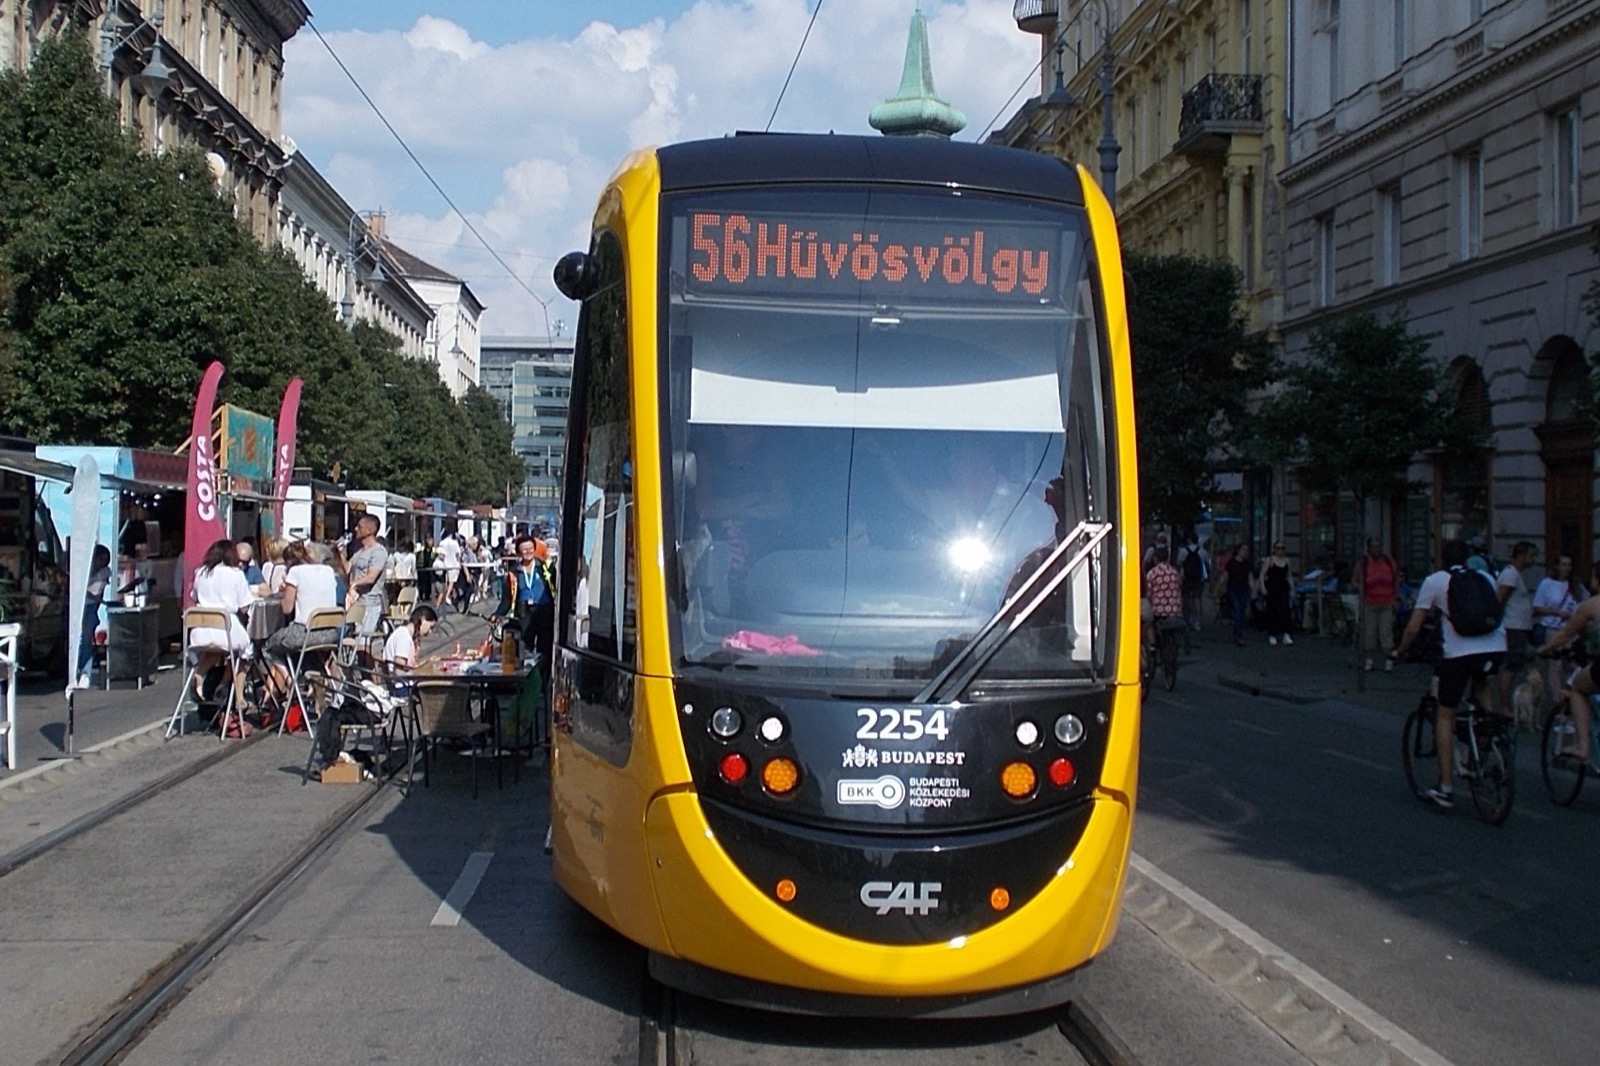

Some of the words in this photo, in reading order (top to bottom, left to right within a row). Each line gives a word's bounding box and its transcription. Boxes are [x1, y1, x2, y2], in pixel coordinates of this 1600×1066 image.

[692, 212, 751, 283] 56
[757, 221, 1049, 294] Hűvösvölgy
[197, 435, 215, 521] COSTA
[856, 708, 949, 740] 2254
[881, 751, 966, 765] BUDAPEST
[847, 787, 875, 797] BKK
[909, 777, 960, 787] BUDAPESTI
[909, 798, 953, 808] KÖZPONT
[860, 881, 942, 915] CAF
